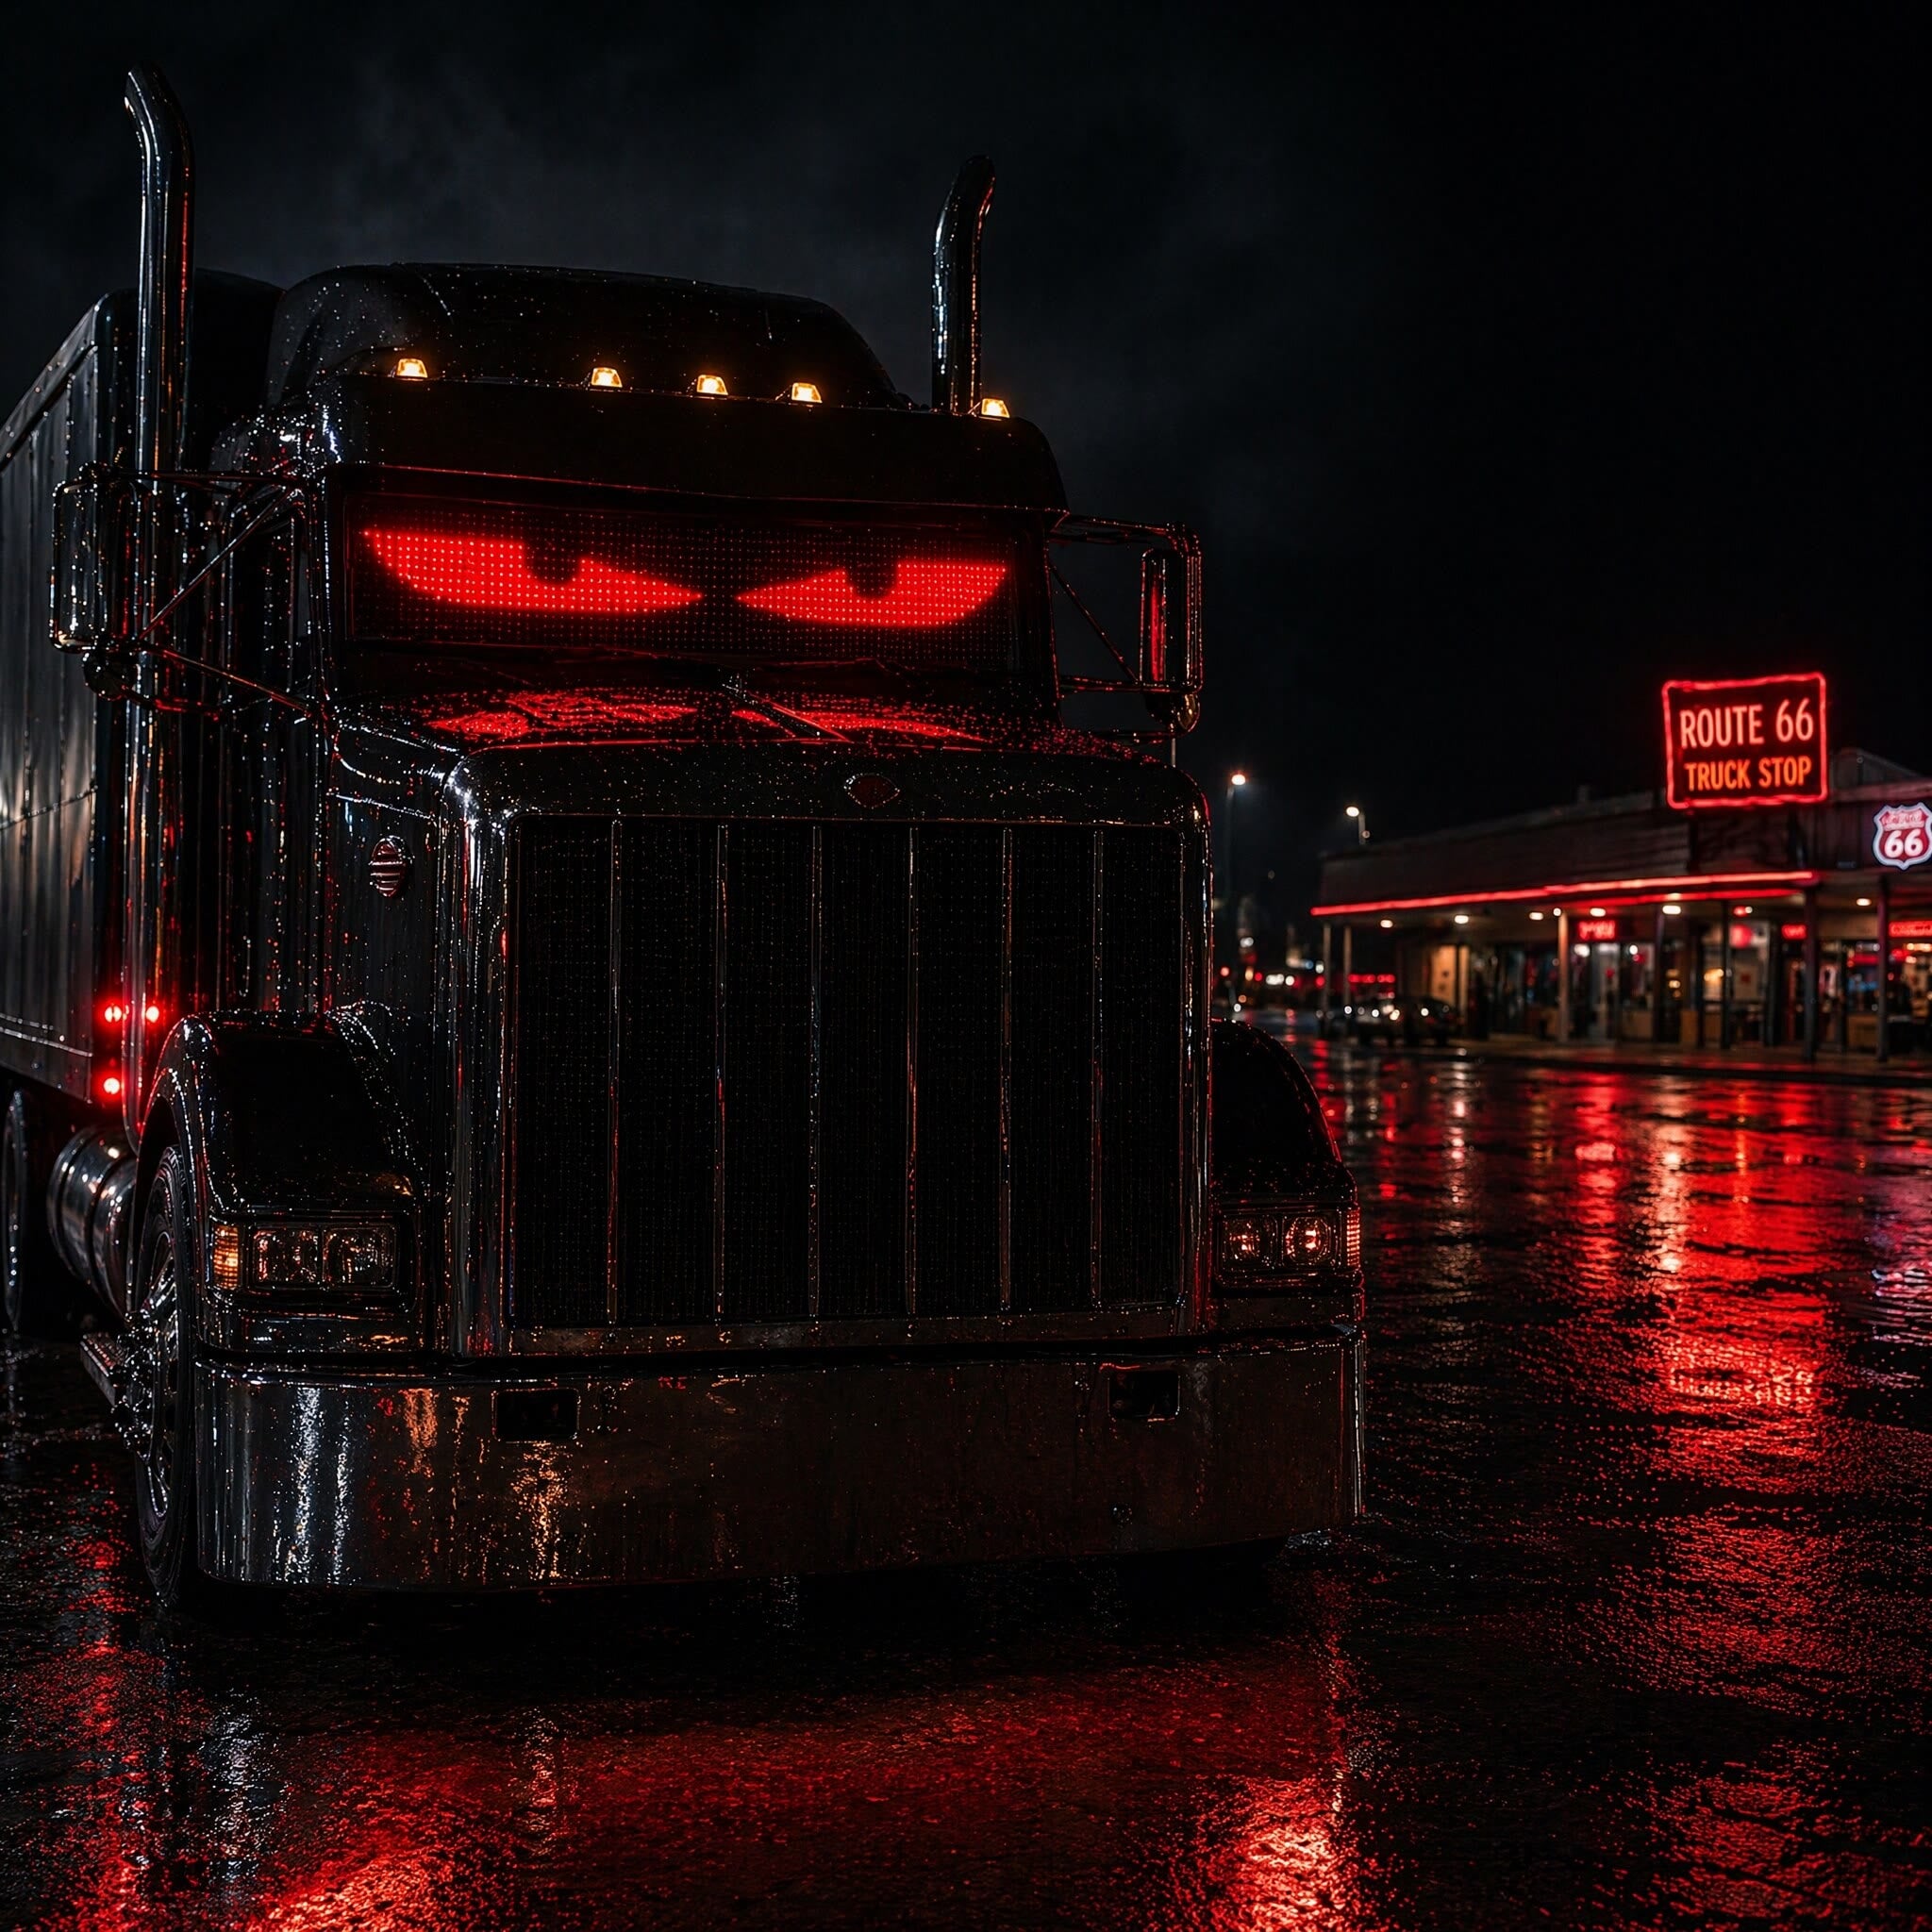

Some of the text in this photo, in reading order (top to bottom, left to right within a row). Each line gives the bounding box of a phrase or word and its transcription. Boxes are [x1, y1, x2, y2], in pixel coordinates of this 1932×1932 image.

[1679, 698, 1814, 749] ROUTE 66
[1685, 756, 1812, 791] TRUCK STOP
[1884, 828, 1924, 858] 66
